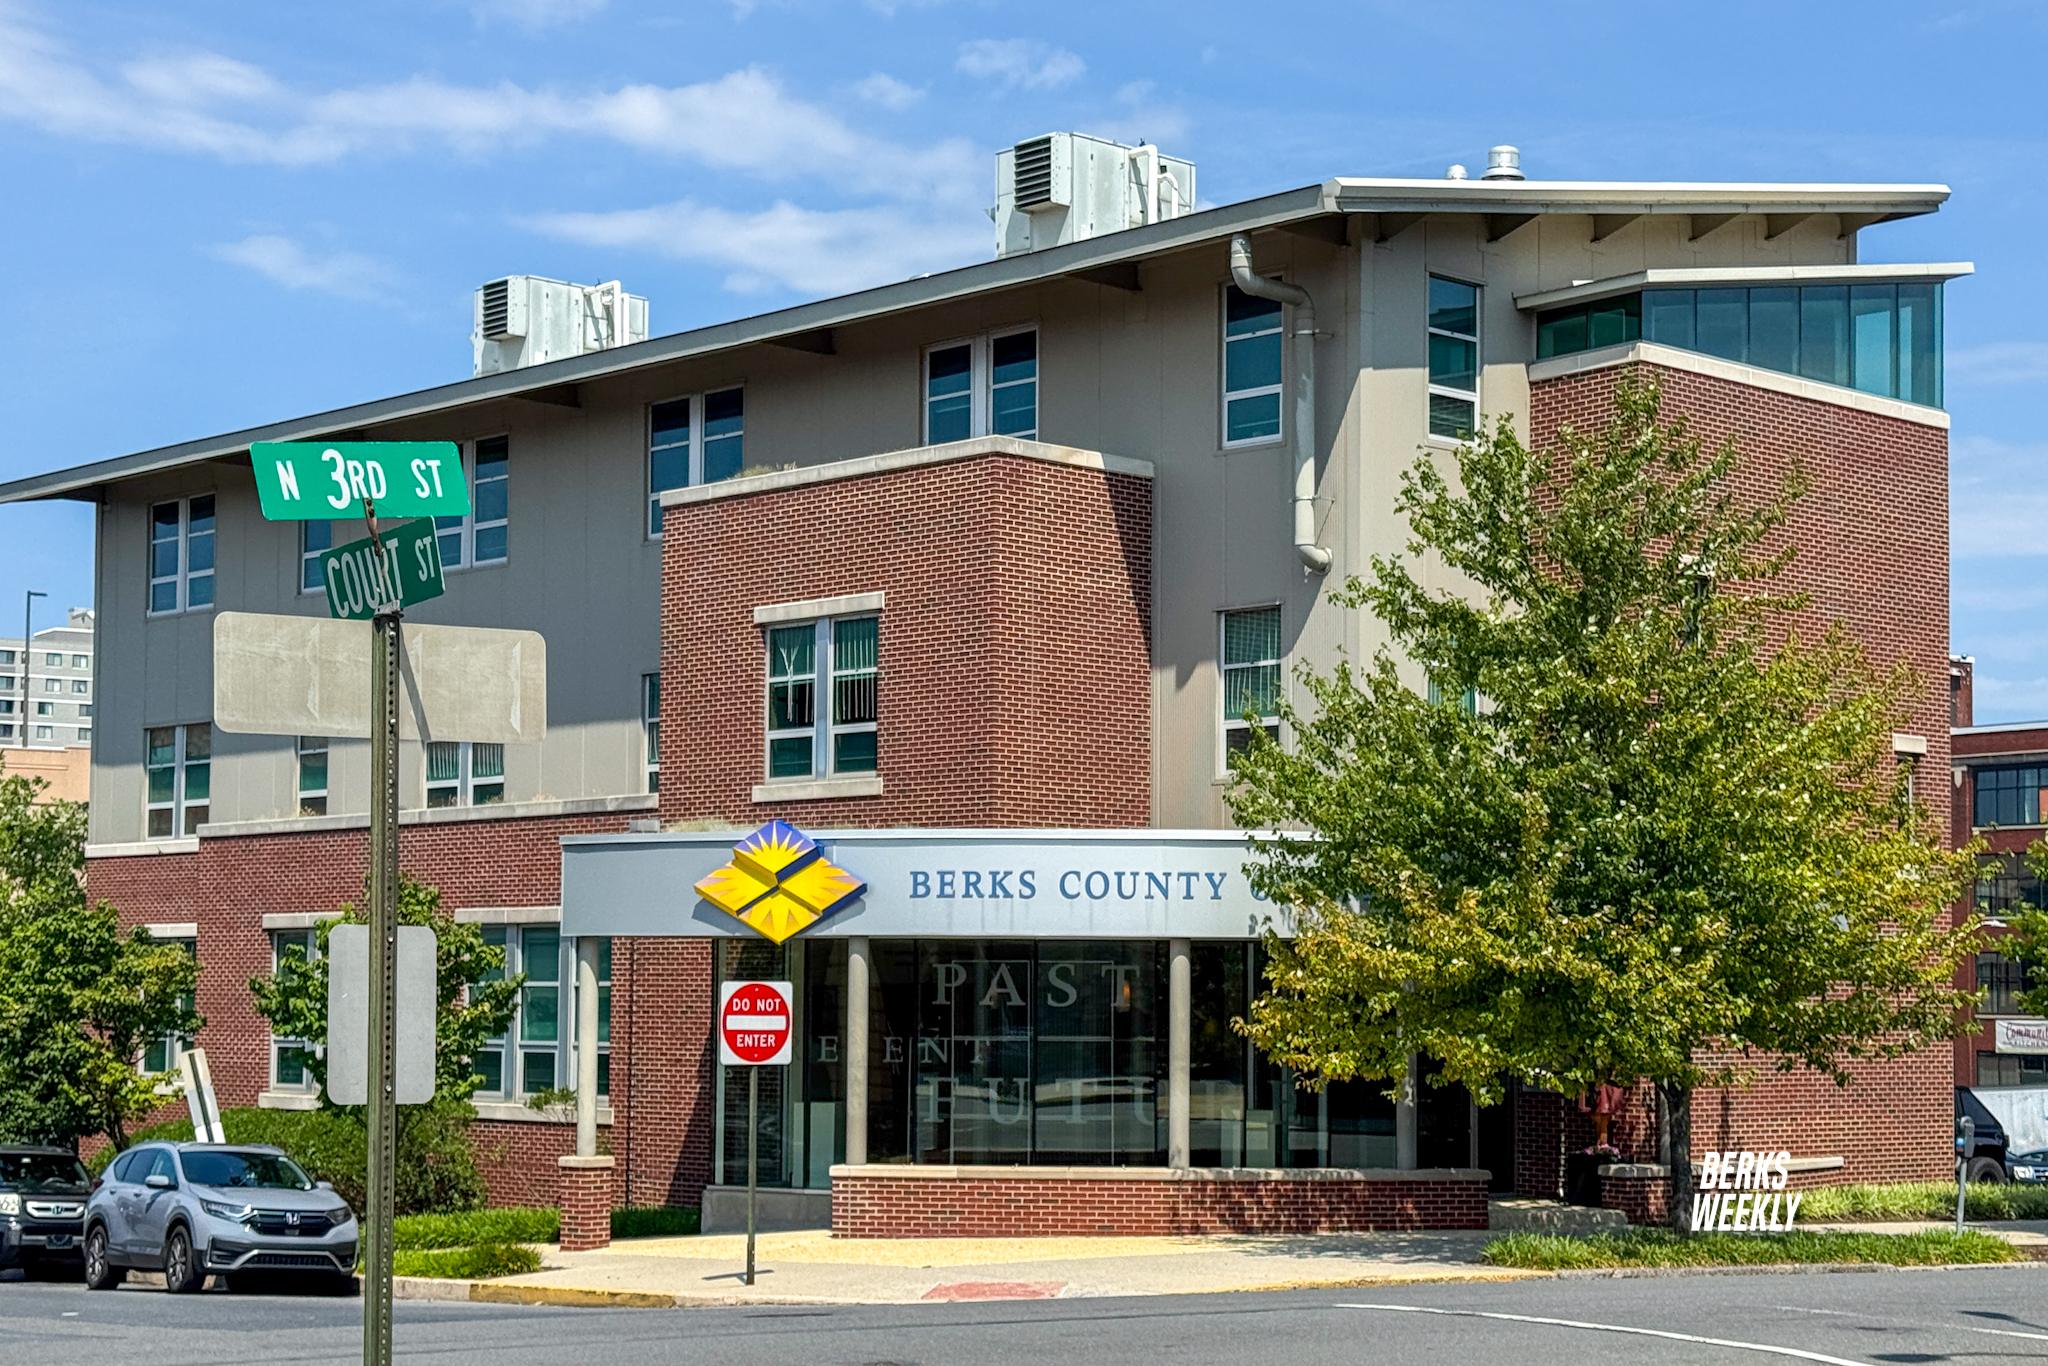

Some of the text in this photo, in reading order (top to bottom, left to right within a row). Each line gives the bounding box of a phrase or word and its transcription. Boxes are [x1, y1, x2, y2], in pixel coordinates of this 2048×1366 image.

[276, 449, 444, 509] N 3RD ST
[326, 536, 436, 618] COURT ST
[909, 870, 1037, 899] BERKS
[1059, 870, 1228, 900] COUNTY
[931, 963, 1140, 1008] PAST
[732, 998, 781, 1012] DO NOT
[736, 1034, 776, 1048] ENTER
